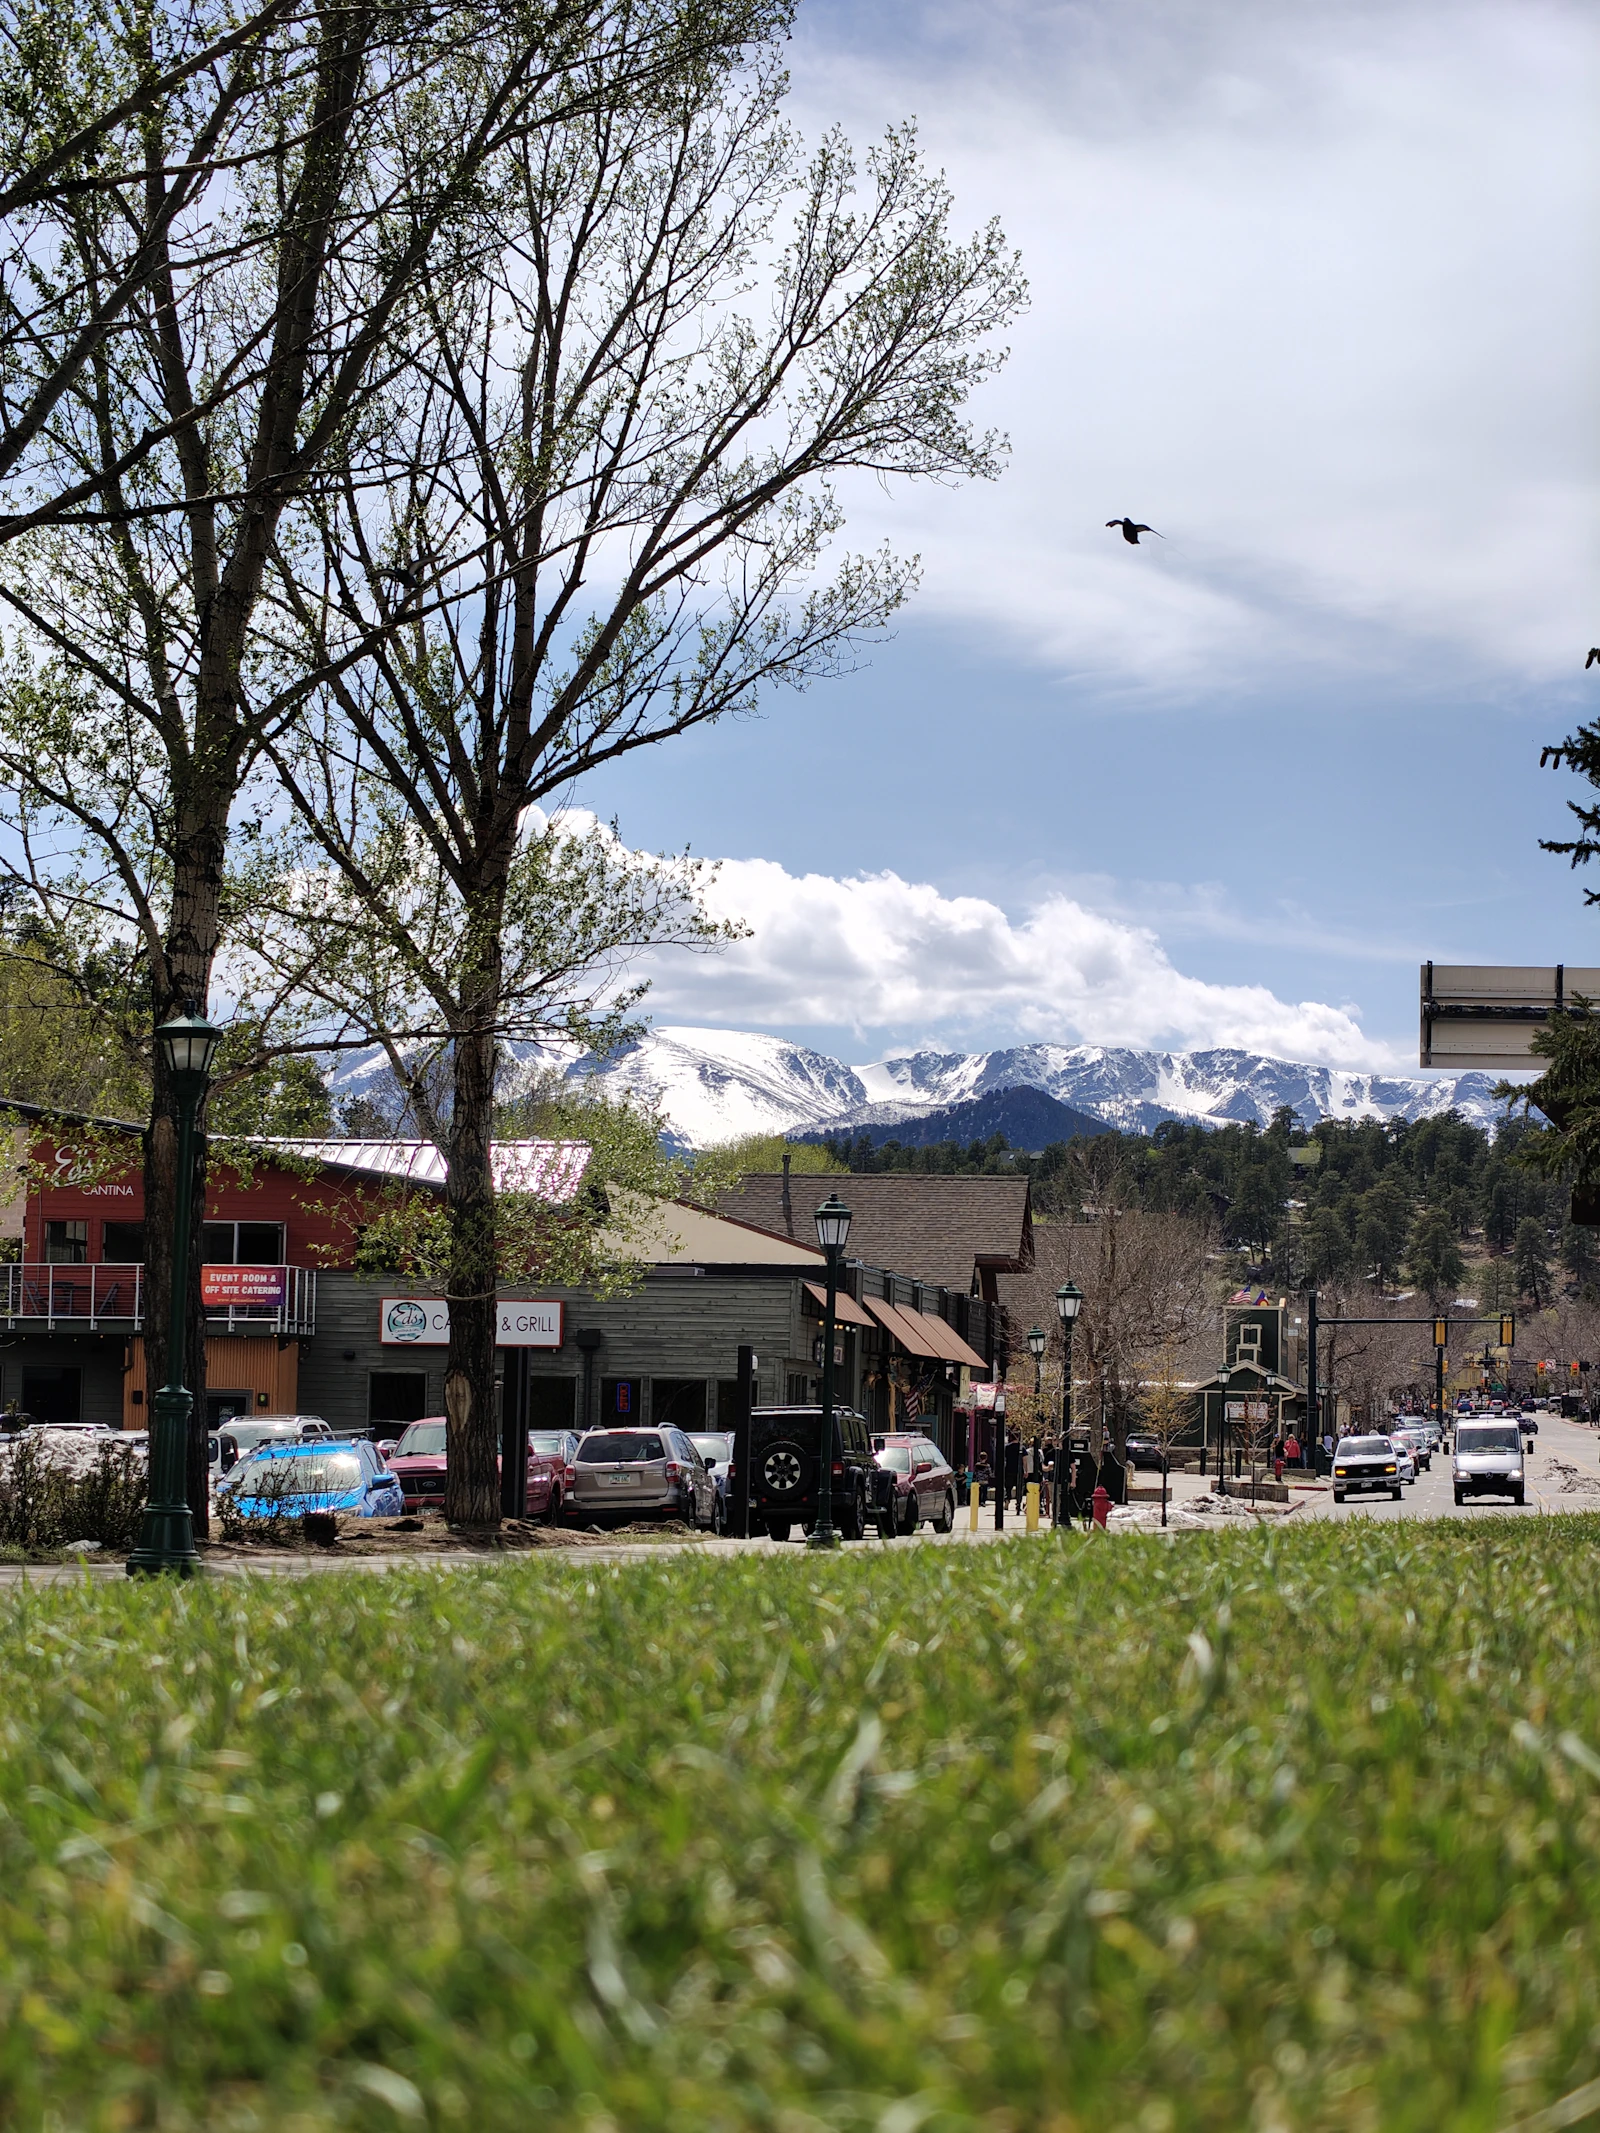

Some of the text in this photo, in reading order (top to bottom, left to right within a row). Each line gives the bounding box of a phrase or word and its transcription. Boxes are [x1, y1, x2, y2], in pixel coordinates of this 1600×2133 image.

[82, 1184, 134, 1196] CANTINA
[210, 1273, 276, 1282] EVENT ROOM &
[204, 1285, 281, 1294] OFF SITE CATERING
[501, 1316, 554, 1332] & GRILL
